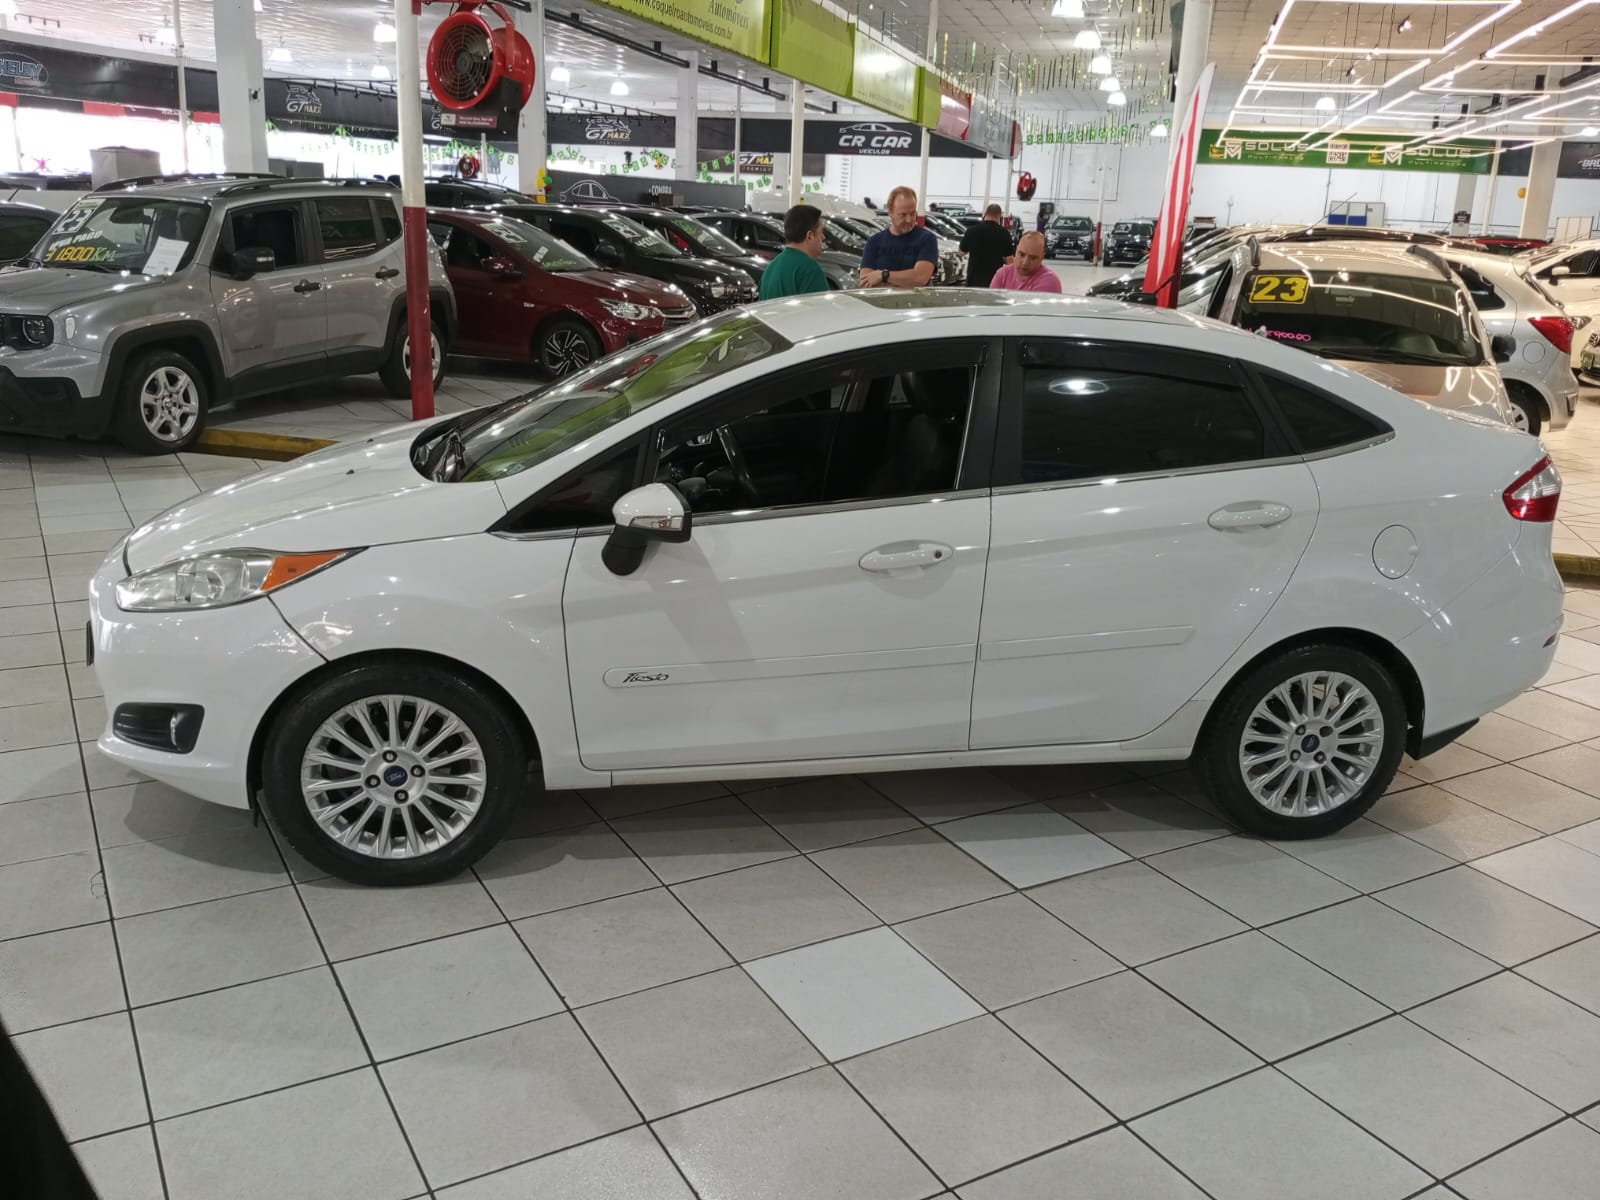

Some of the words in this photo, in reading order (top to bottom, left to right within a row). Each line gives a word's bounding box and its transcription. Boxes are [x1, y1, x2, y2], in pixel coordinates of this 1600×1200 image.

[633, 0, 733, 39] ww.coqueiroautomoveis.com.br
[839, 135, 866, 147] CR
[871, 136, 912, 149] CAR
[1245, 141, 1309, 152] SOLUS
[1253, 277, 1307, 301] 23
